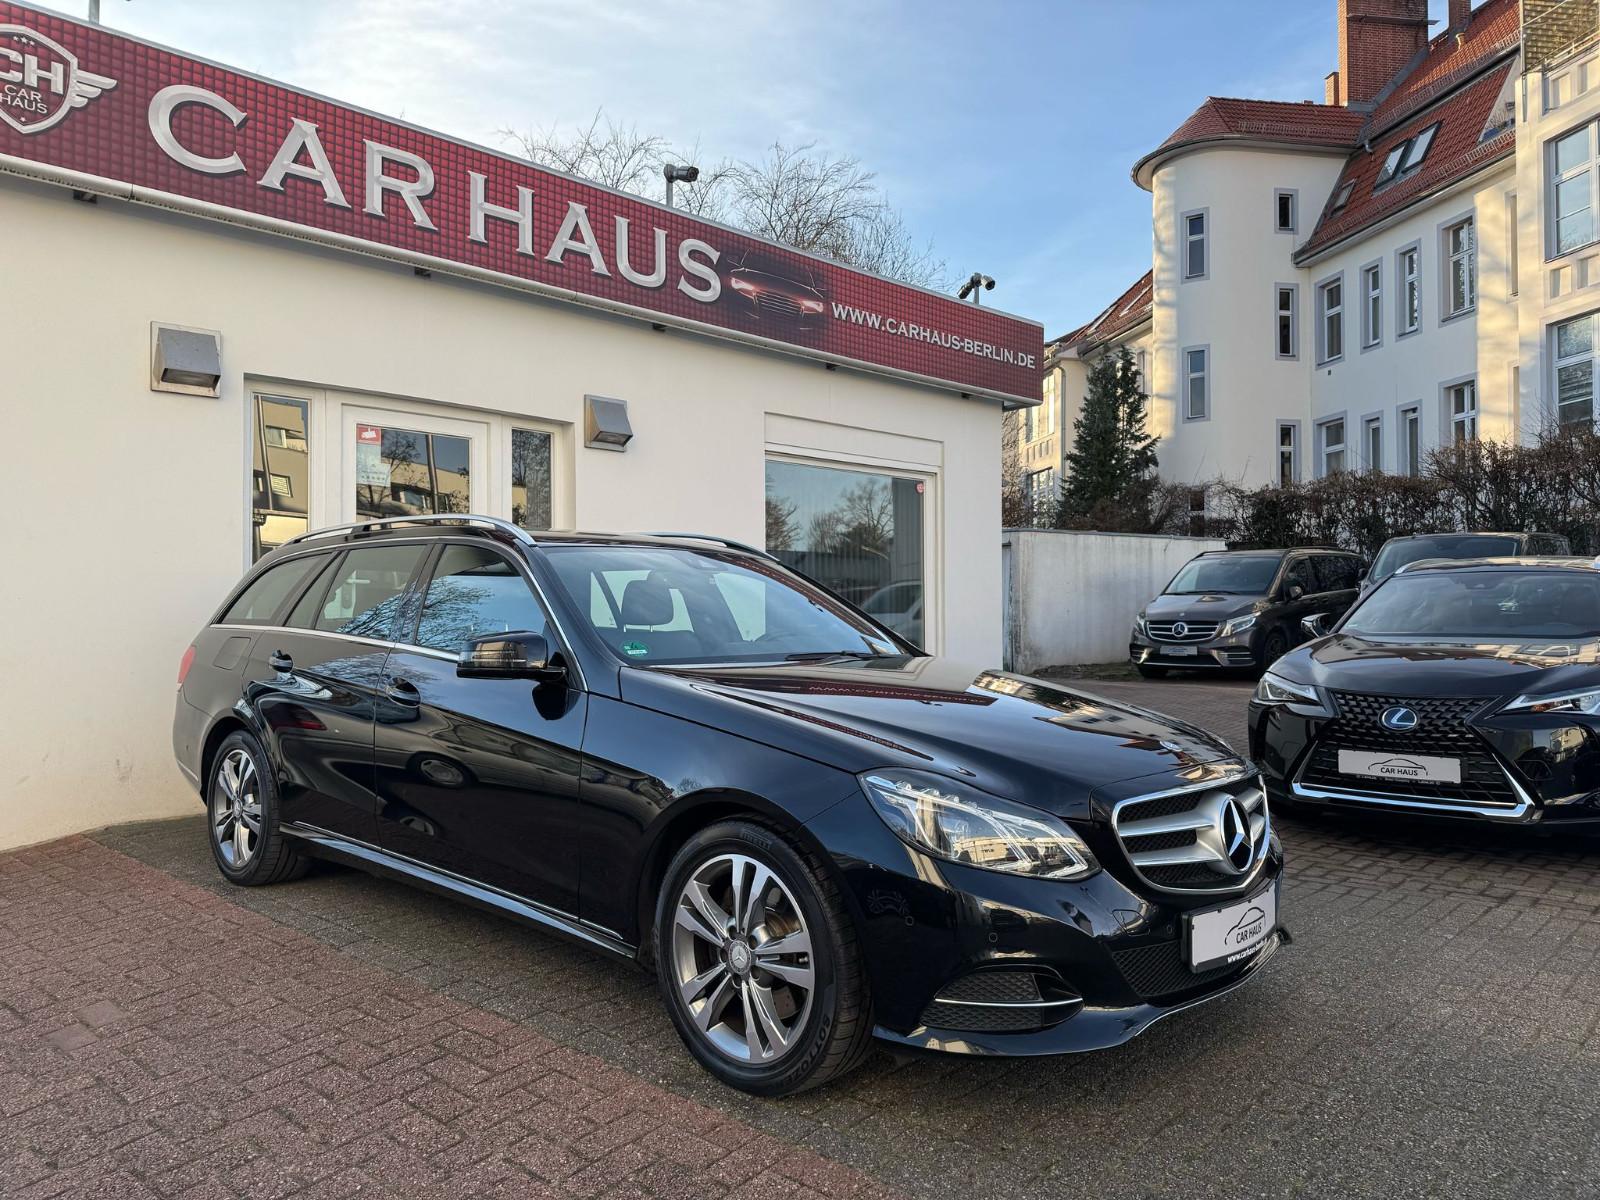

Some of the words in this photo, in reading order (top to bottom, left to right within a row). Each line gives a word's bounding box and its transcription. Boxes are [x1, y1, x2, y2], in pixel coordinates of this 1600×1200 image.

[0, 92, 48, 114] HAUS
[4, 84, 42, 102] CAR
[148, 84, 438, 231] CAR
[468, 170, 722, 302] HAUS
[831, 302, 1036, 369] WWW.CARHAUS-BERLIN.DE
[1380, 766, 1396, 775] CAR
[1397, 769, 1418, 777] HAUS
[1236, 930, 1249, 944] CAR
[1249, 922, 1262, 939] HAUS
